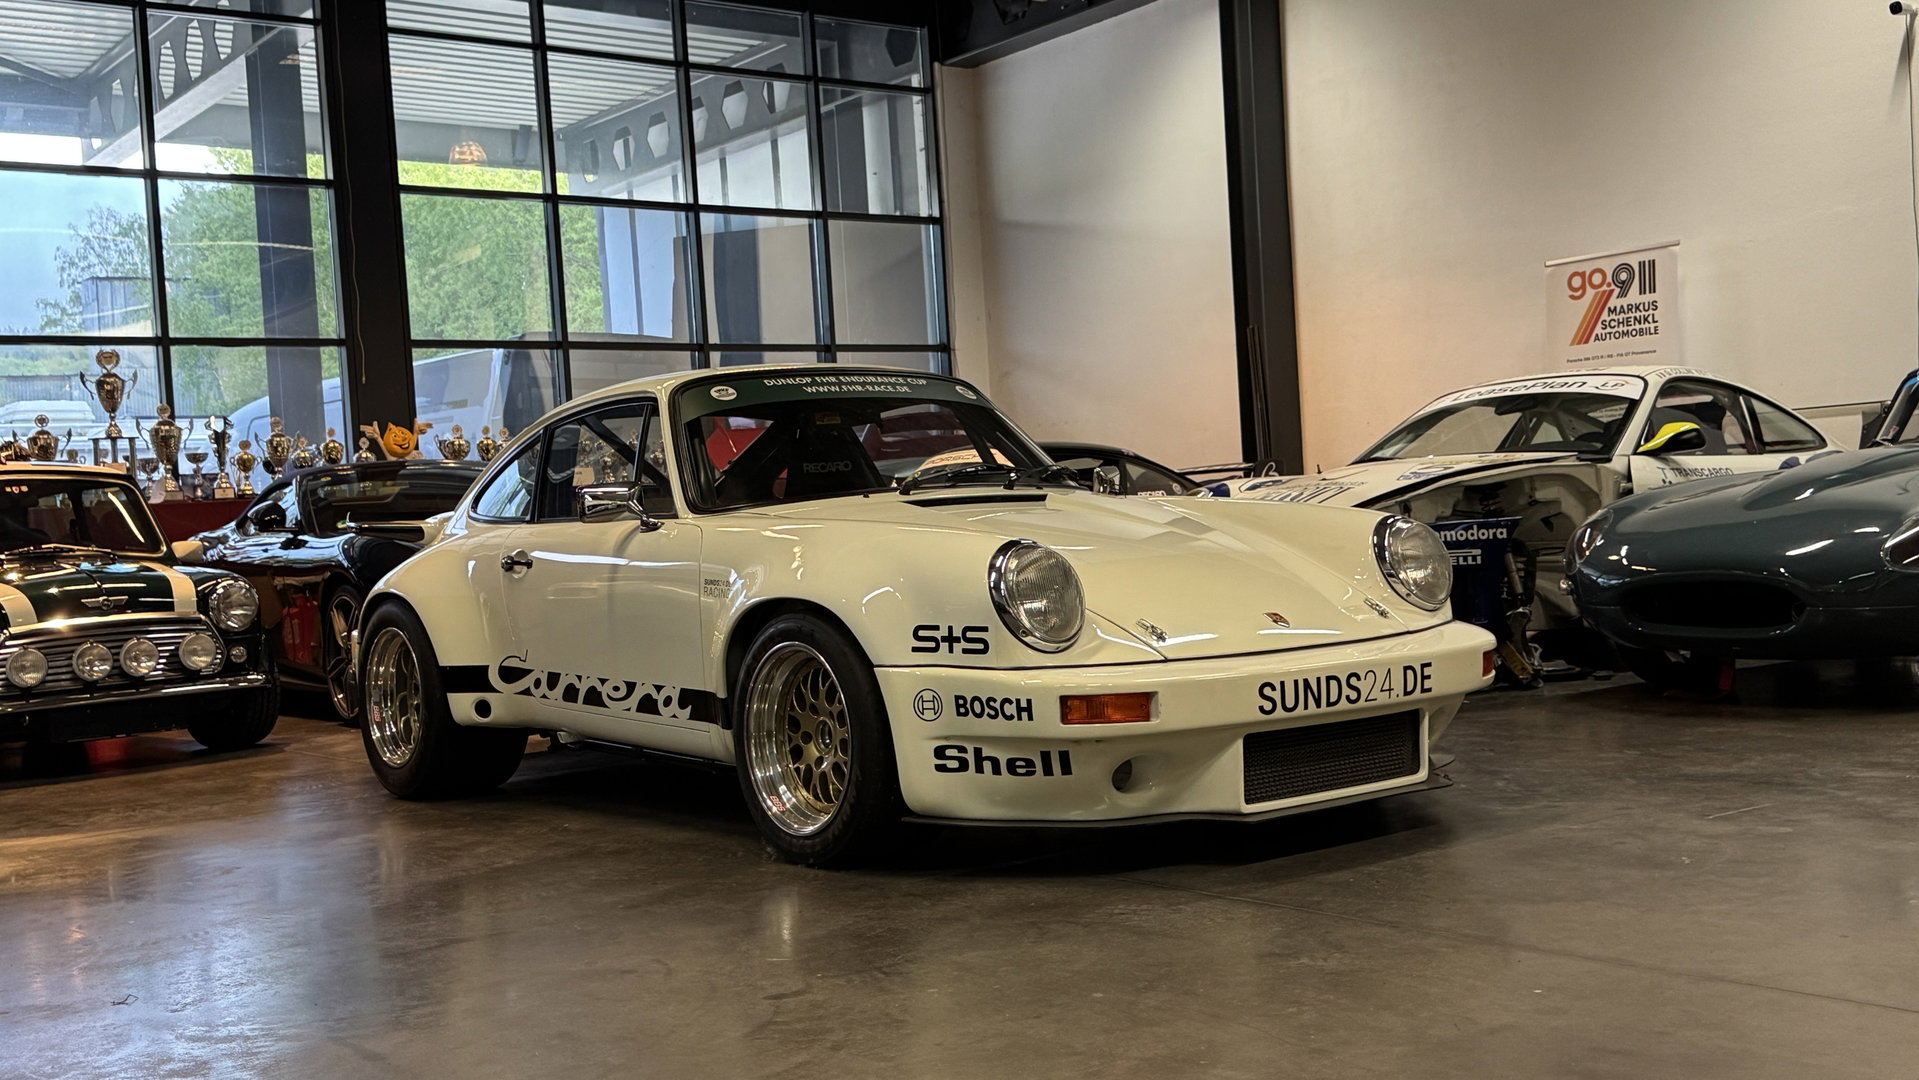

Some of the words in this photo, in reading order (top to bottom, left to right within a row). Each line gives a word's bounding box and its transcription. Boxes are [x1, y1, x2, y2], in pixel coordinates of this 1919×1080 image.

[1567, 259, 1656, 301] go.911
[1607, 300, 1658, 317] MARKUS
[1601, 313, 1659, 330] SCHENKL
[1593, 326, 1659, 343] AUTOMOBILE
[763, 377, 812, 387] DUNLOP
[814, 376, 839, 384] FHR
[839, 376, 907, 384] ENDURANCE
[906, 377, 928, 386] CUP
[802, 385, 912, 393] WWW.FHR-RACE.DE
[1451, 380, 1587, 401] LeasePlan
[803, 460, 852, 473] RECARO
[1669, 467, 1735, 479] TRANSCARGO
[1439, 524, 1507, 542] modora
[911, 624, 990, 655] S+S
[488, 649, 692, 720] Carrera
[1257, 661, 1433, 716] SUNDS24.DE
[953, 694, 1035, 722] BOSCH
[933, 744, 1073, 777] Shell
